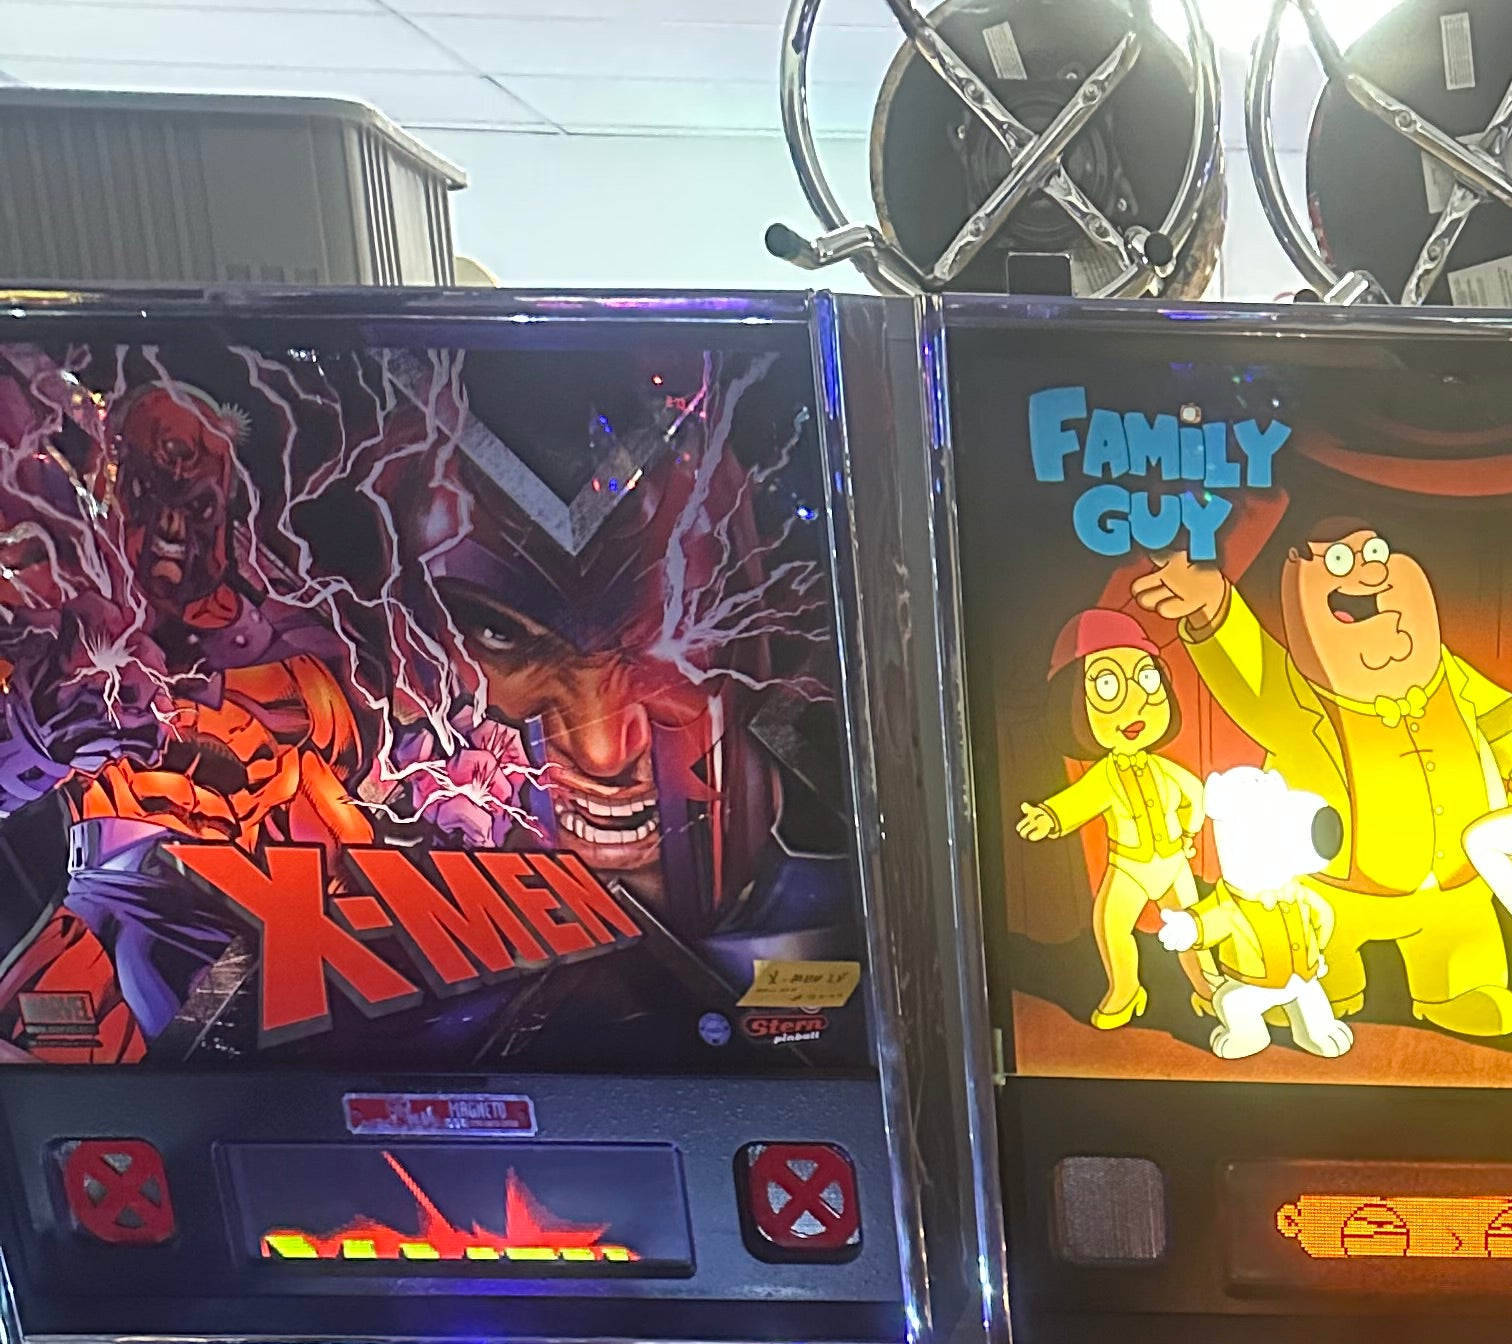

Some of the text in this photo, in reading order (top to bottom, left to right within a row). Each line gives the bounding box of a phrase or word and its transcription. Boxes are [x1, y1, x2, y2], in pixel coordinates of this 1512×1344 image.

[1029, 386, 1292, 488] FAMILY
[1072, 484, 1233, 560] GUY
[161, 844, 643, 1035] X-MEN
[752, 1018, 822, 1035] Stern
[773, 1031, 820, 1045] pinball
